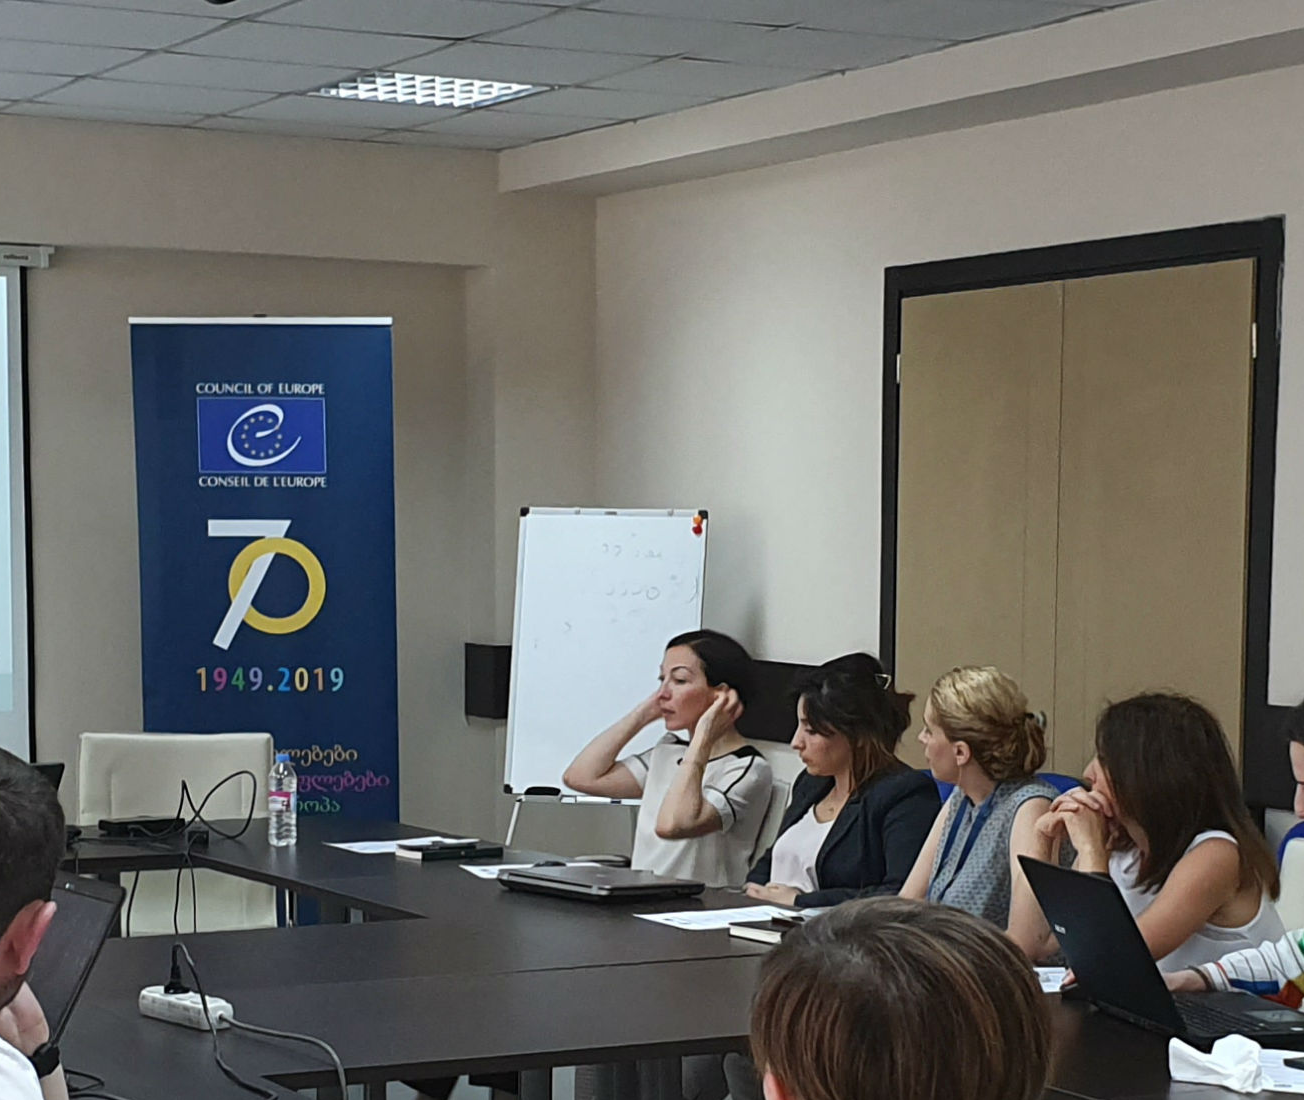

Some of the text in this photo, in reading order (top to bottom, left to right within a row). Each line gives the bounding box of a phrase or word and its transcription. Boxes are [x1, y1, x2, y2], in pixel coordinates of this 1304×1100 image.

[195, 383, 325, 395] COUNCIL OF EUROPE
[198, 476, 327, 488] CONSEIL DE L'EUROPE
[208, 519, 327, 651] 70
[196, 666, 345, 693] 1949.2019
